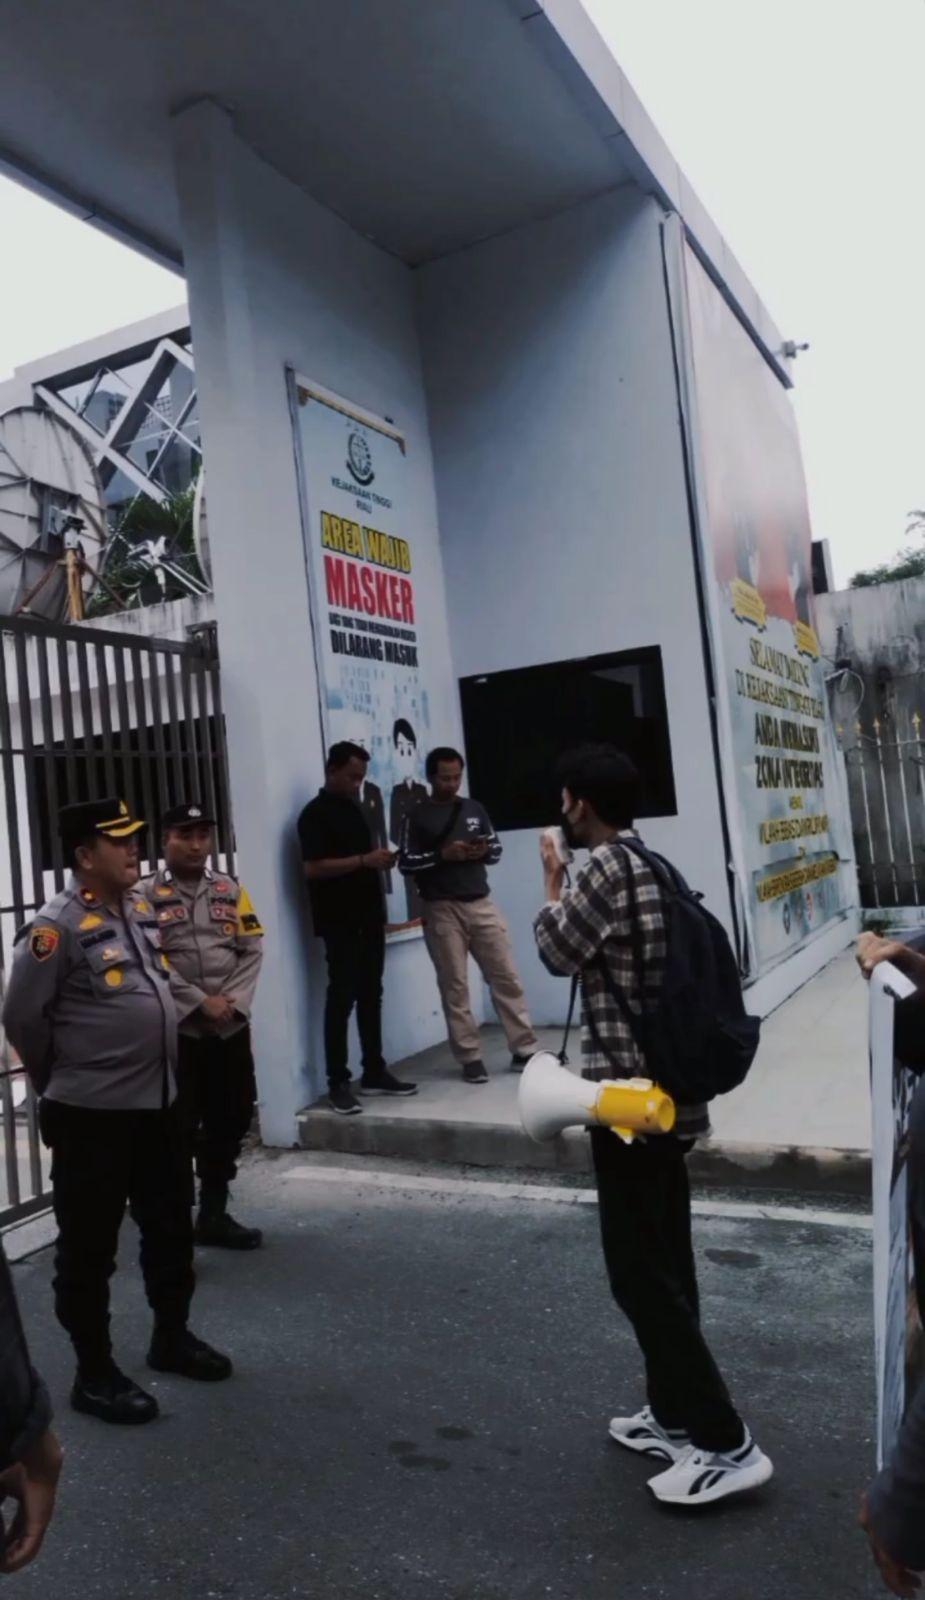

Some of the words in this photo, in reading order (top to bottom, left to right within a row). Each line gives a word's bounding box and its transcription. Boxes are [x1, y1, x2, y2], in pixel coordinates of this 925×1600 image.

[320, 510, 364, 561] AREA
[362, 526, 411, 574] WAJIB
[323, 554, 415, 625] MASKER
[330, 629, 384, 662] DILARANG
[384, 640, 419, 668] MASUK
[755, 754, 781, 789] ZONA
